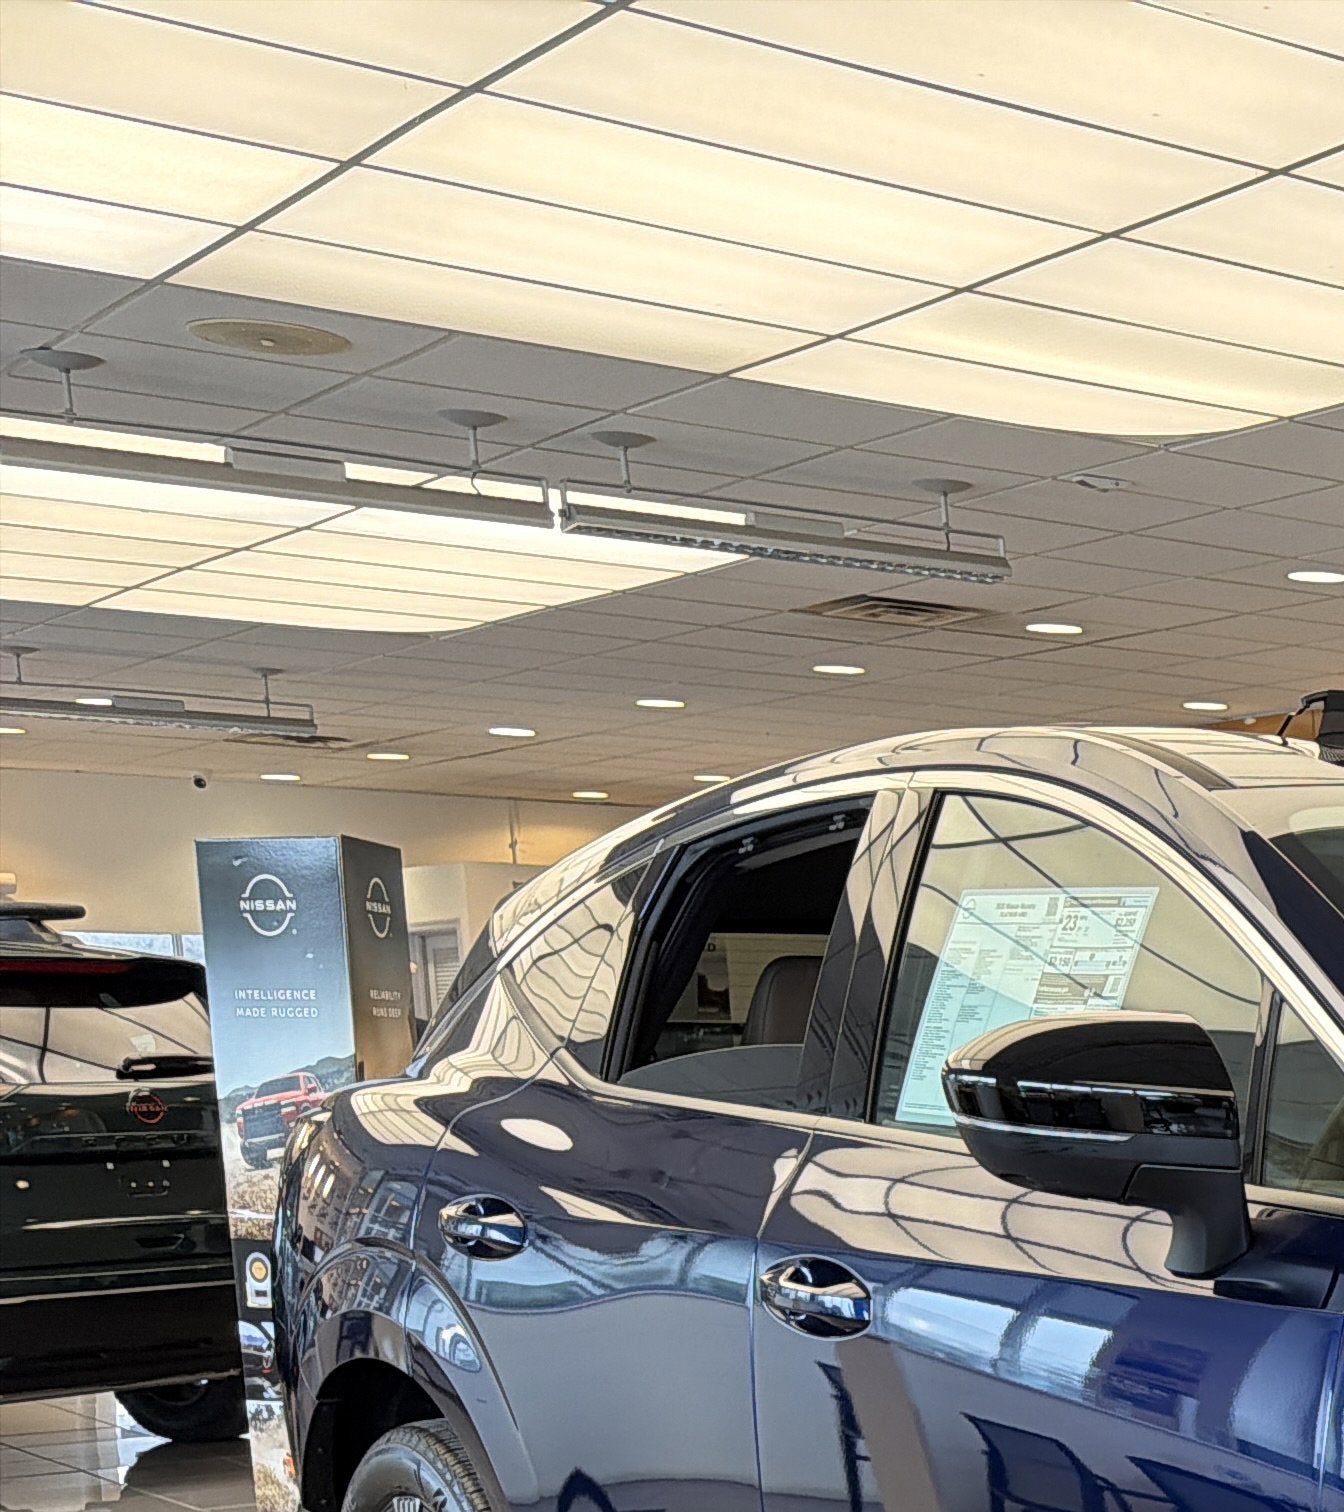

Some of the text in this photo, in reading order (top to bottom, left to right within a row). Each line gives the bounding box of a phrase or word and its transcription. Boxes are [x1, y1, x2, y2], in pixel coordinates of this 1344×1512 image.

[240, 899, 297, 911] NISSAN
[366, 901, 391, 914] NISSAN
[234, 989, 317, 1000] INTELLIGENCE
[236, 1007, 319, 1018] MADE RUGGED
